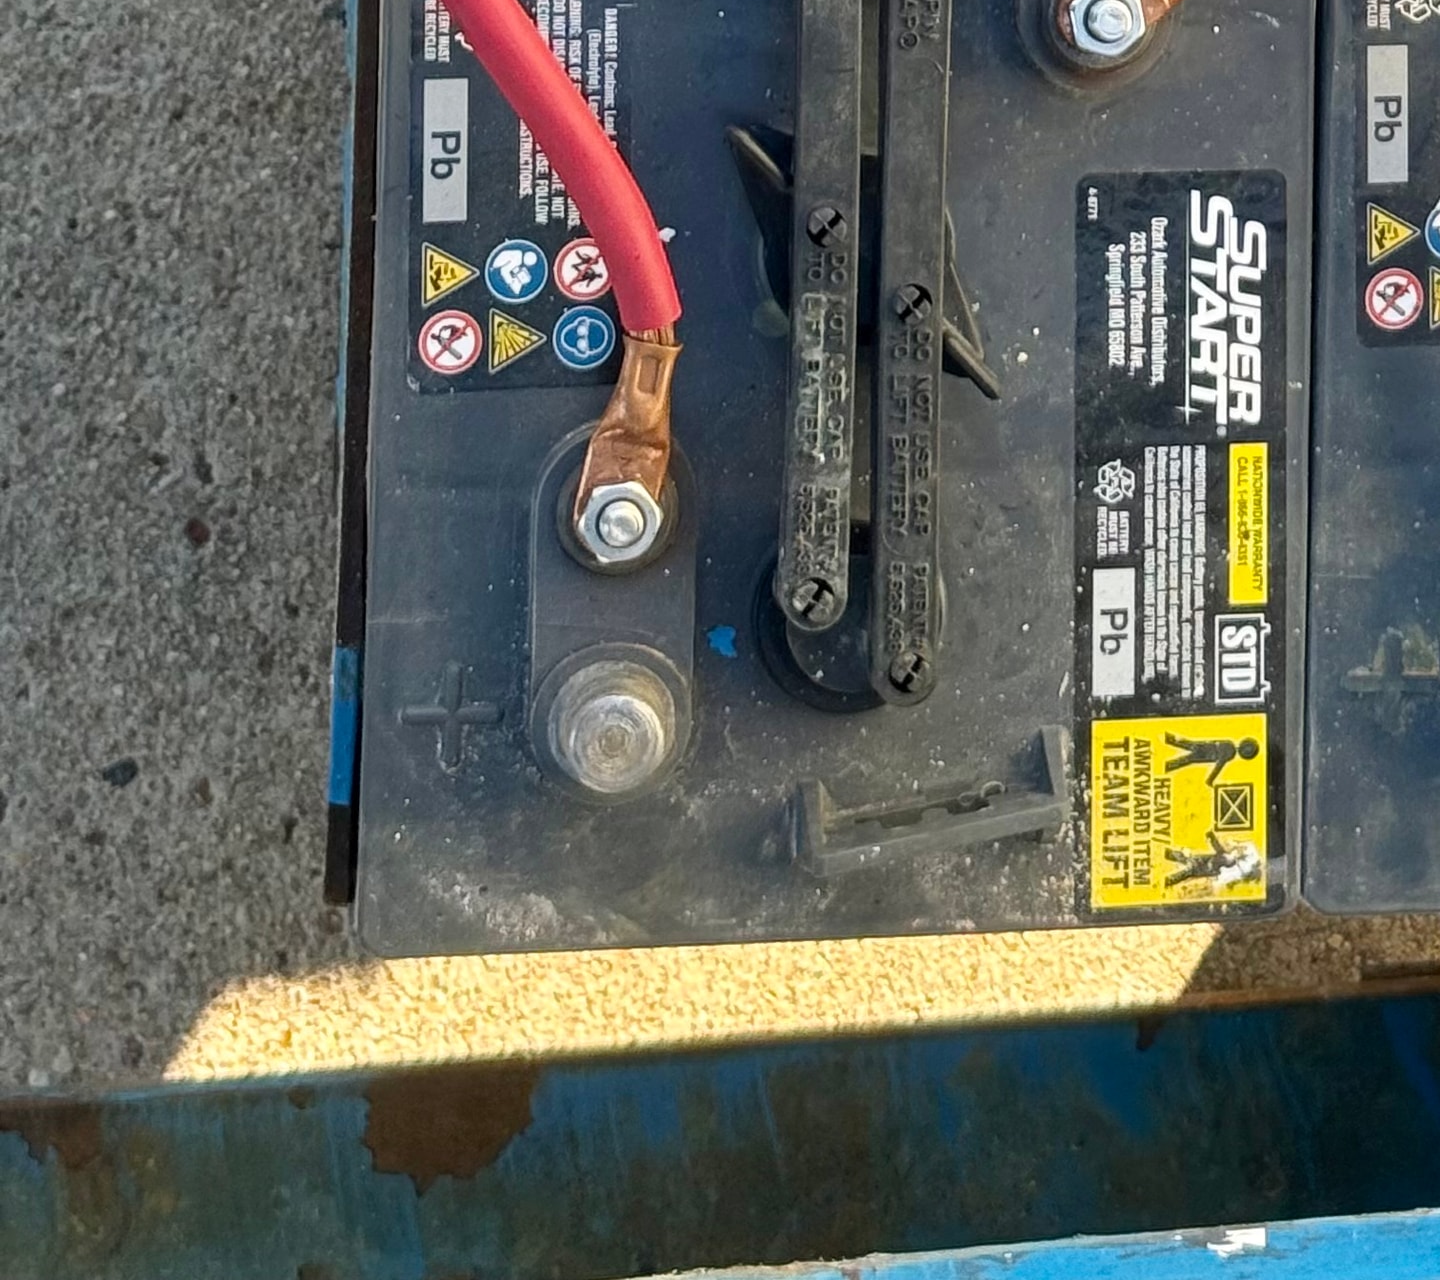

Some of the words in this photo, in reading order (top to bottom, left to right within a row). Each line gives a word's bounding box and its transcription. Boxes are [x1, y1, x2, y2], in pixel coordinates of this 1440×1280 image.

[1373, 94, 1403, 143] Pb
[431, 131, 462, 181] Pb
[1130, 231, 1147, 252] 233
[1151, 217, 1168, 248] Ozark
[1106, 243, 1126, 306] Springfield
[1130, 254, 1147, 288] South
[1151, 250, 1168, 314] Automotive
[1109, 308, 1125, 327] MO
[1129, 290, 1147, 344] Patterson
[1190, 189, 1234, 425] START
[1229, 216, 1268, 424] SUPER
[1109, 330, 1125, 365] 65802
[1149, 316, 1168, 388] Distributors,
[1252, 455, 1264, 525] NATIONWIDE
[1251, 529, 1264, 591] WARRANTY
[1099, 606, 1129, 656] Pb
[1220, 624, 1257, 692] STD
[1102, 735, 1130, 818] TEAM
[1133, 737, 1151, 833] AWKWARD
[1152, 777, 1171, 845] HEAVY/
[1102, 828, 1130, 889] LIFT
[1133, 840, 1151, 886] ITEM
